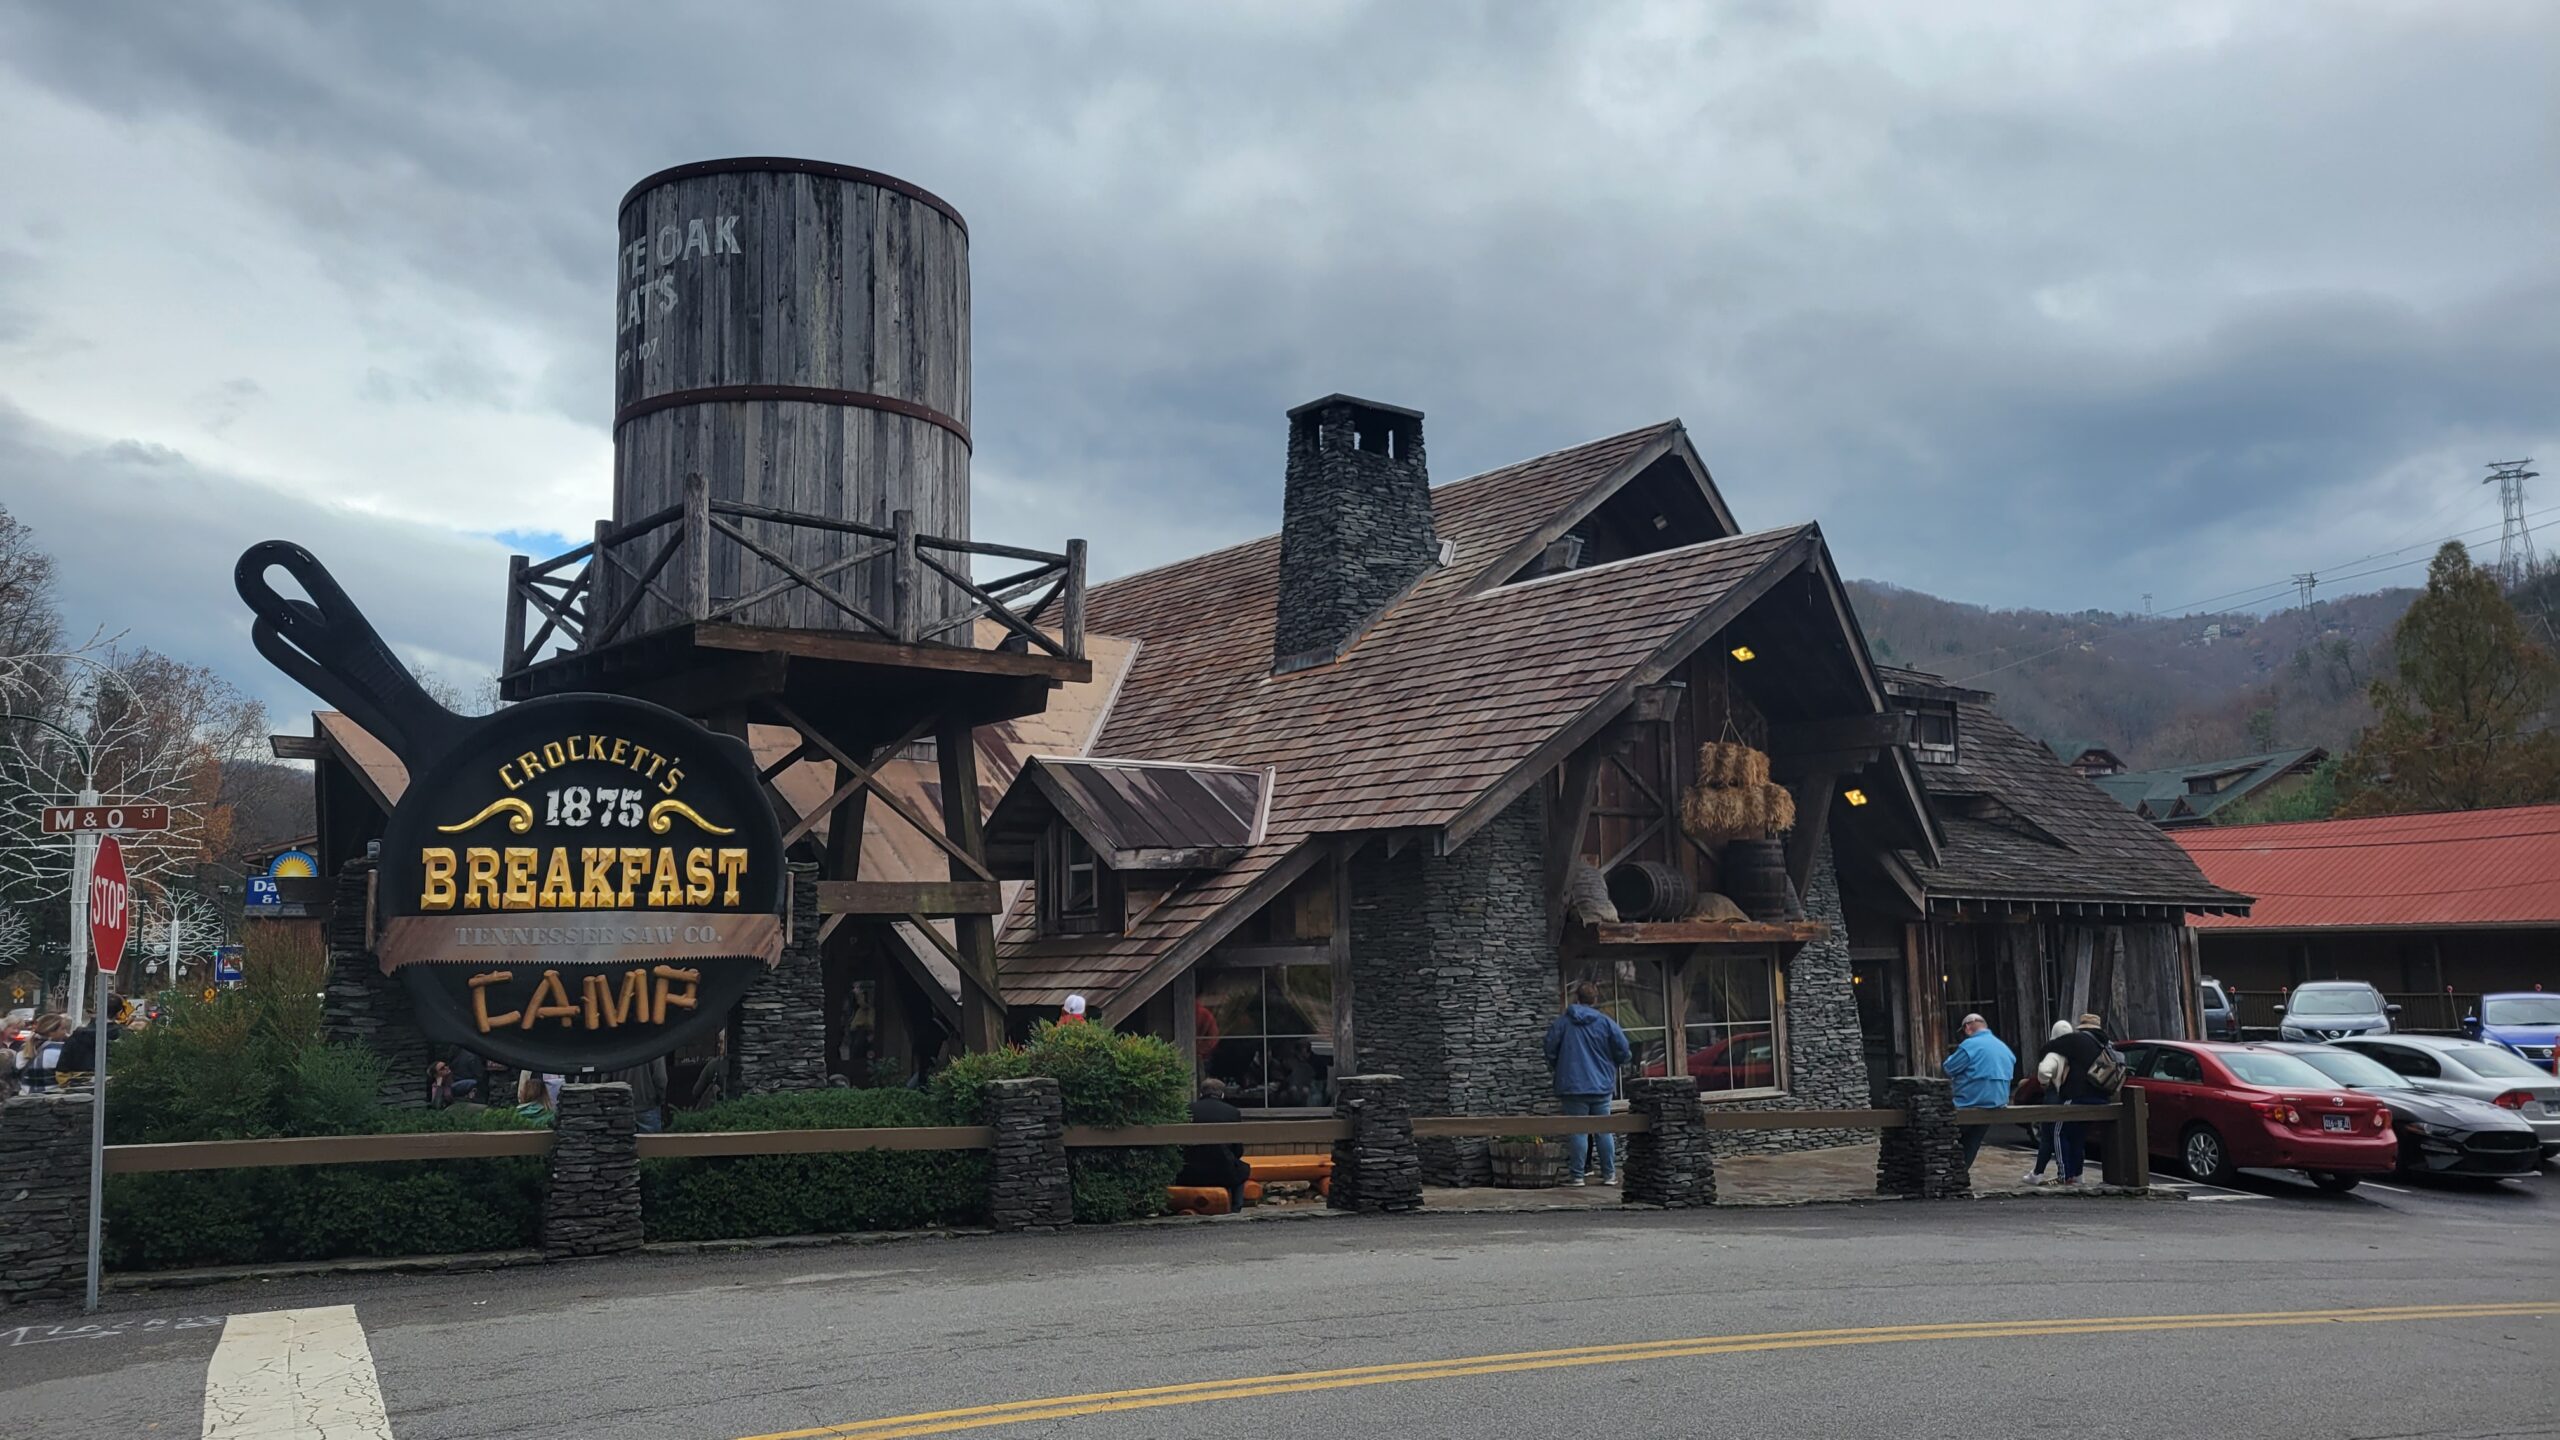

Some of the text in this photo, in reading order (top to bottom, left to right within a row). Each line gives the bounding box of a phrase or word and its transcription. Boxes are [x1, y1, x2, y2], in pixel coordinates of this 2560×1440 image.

[656, 215, 742, 266] OAK
[618, 274, 679, 335] LATS
[638, 337, 659, 361] 107
[498, 734, 686, 795] CROCKETT'S
[55, 808, 157, 830] M & O ST
[545, 786, 644, 827] 1875
[93, 875, 126, 930] STOP
[253, 880, 278, 892] Da
[420, 847, 748, 910] BREAKFAST
[455, 925, 723, 946] TENNESSEE SAW CO.
[468, 964, 701, 1033] CAMP
